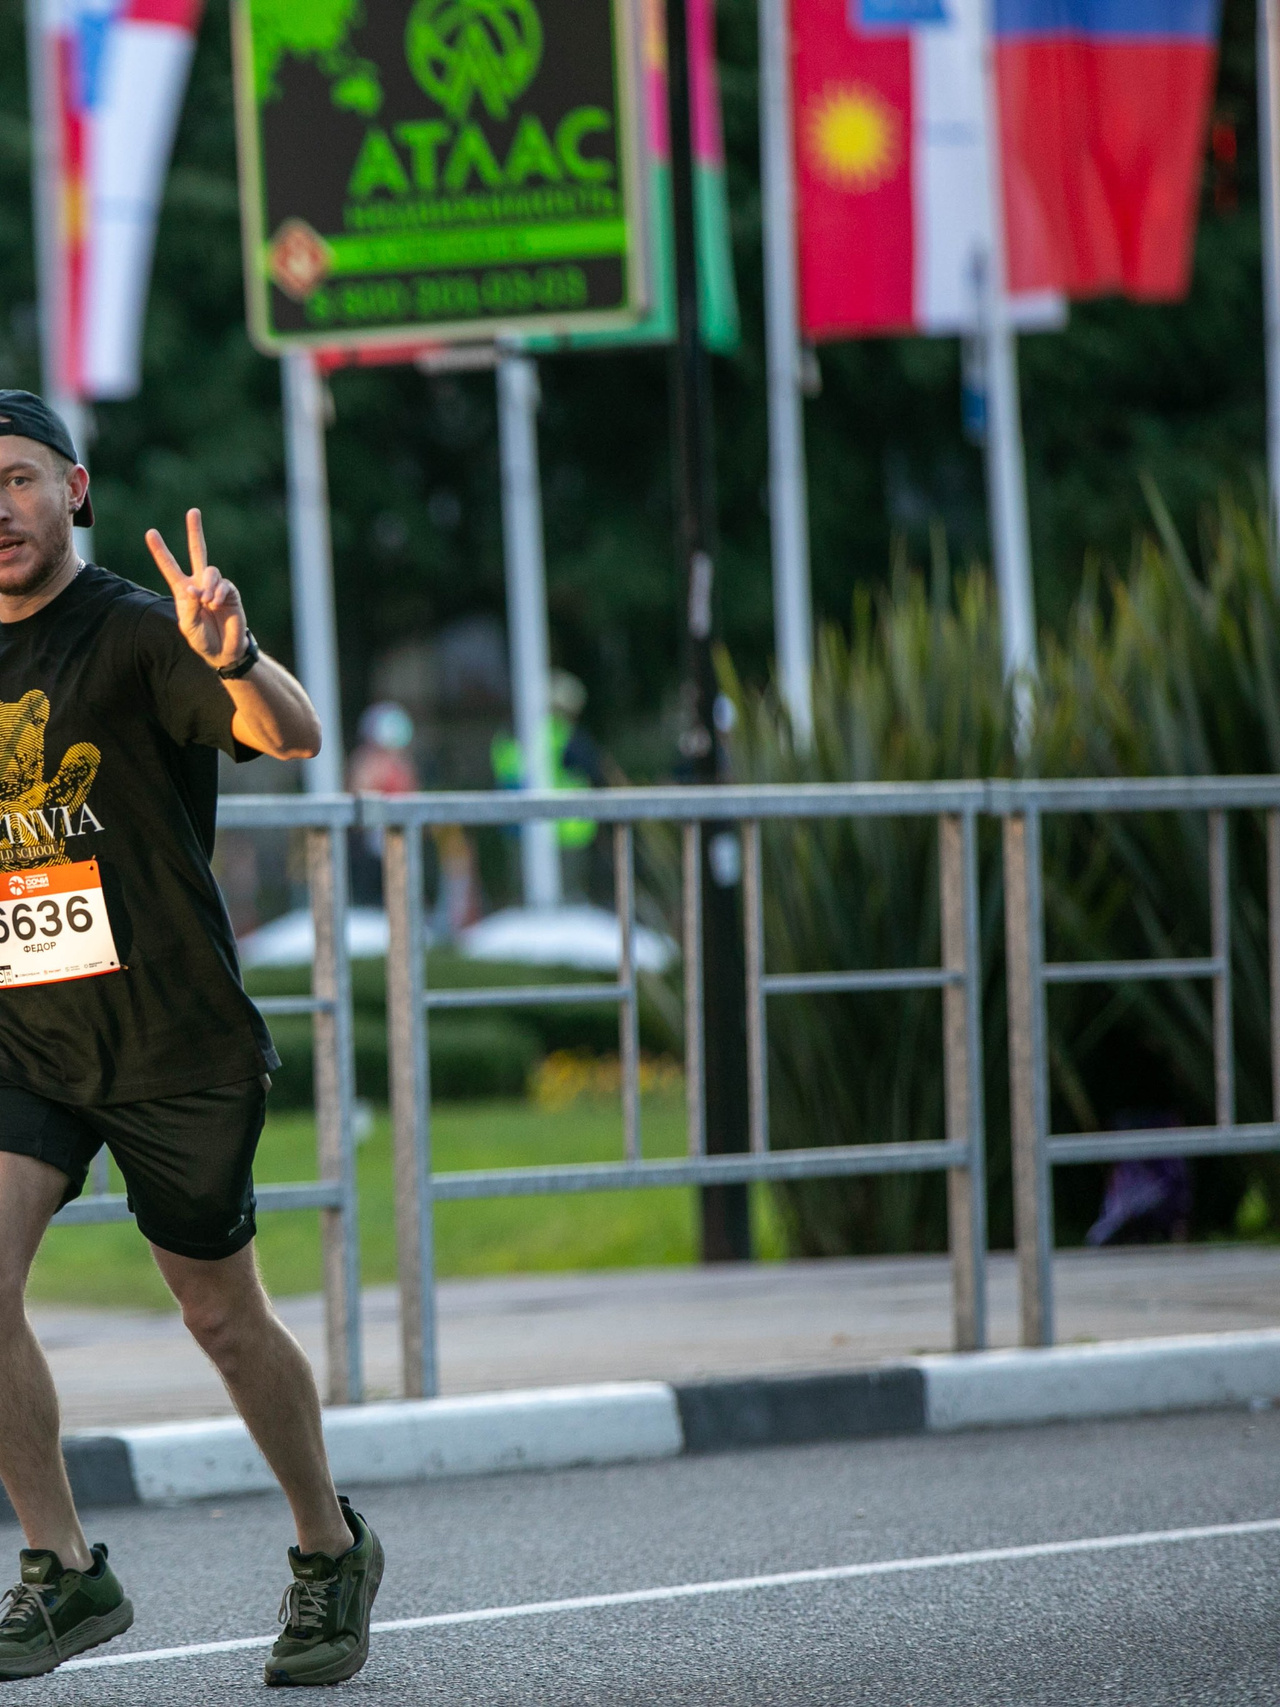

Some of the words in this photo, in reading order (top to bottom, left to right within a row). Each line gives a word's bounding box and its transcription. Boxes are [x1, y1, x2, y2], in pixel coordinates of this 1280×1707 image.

[16, 843, 60, 859] SCHOOL
[25, 876, 49, 886] СОЧИ
[23, 941, 57, 954] ФЕДОР
